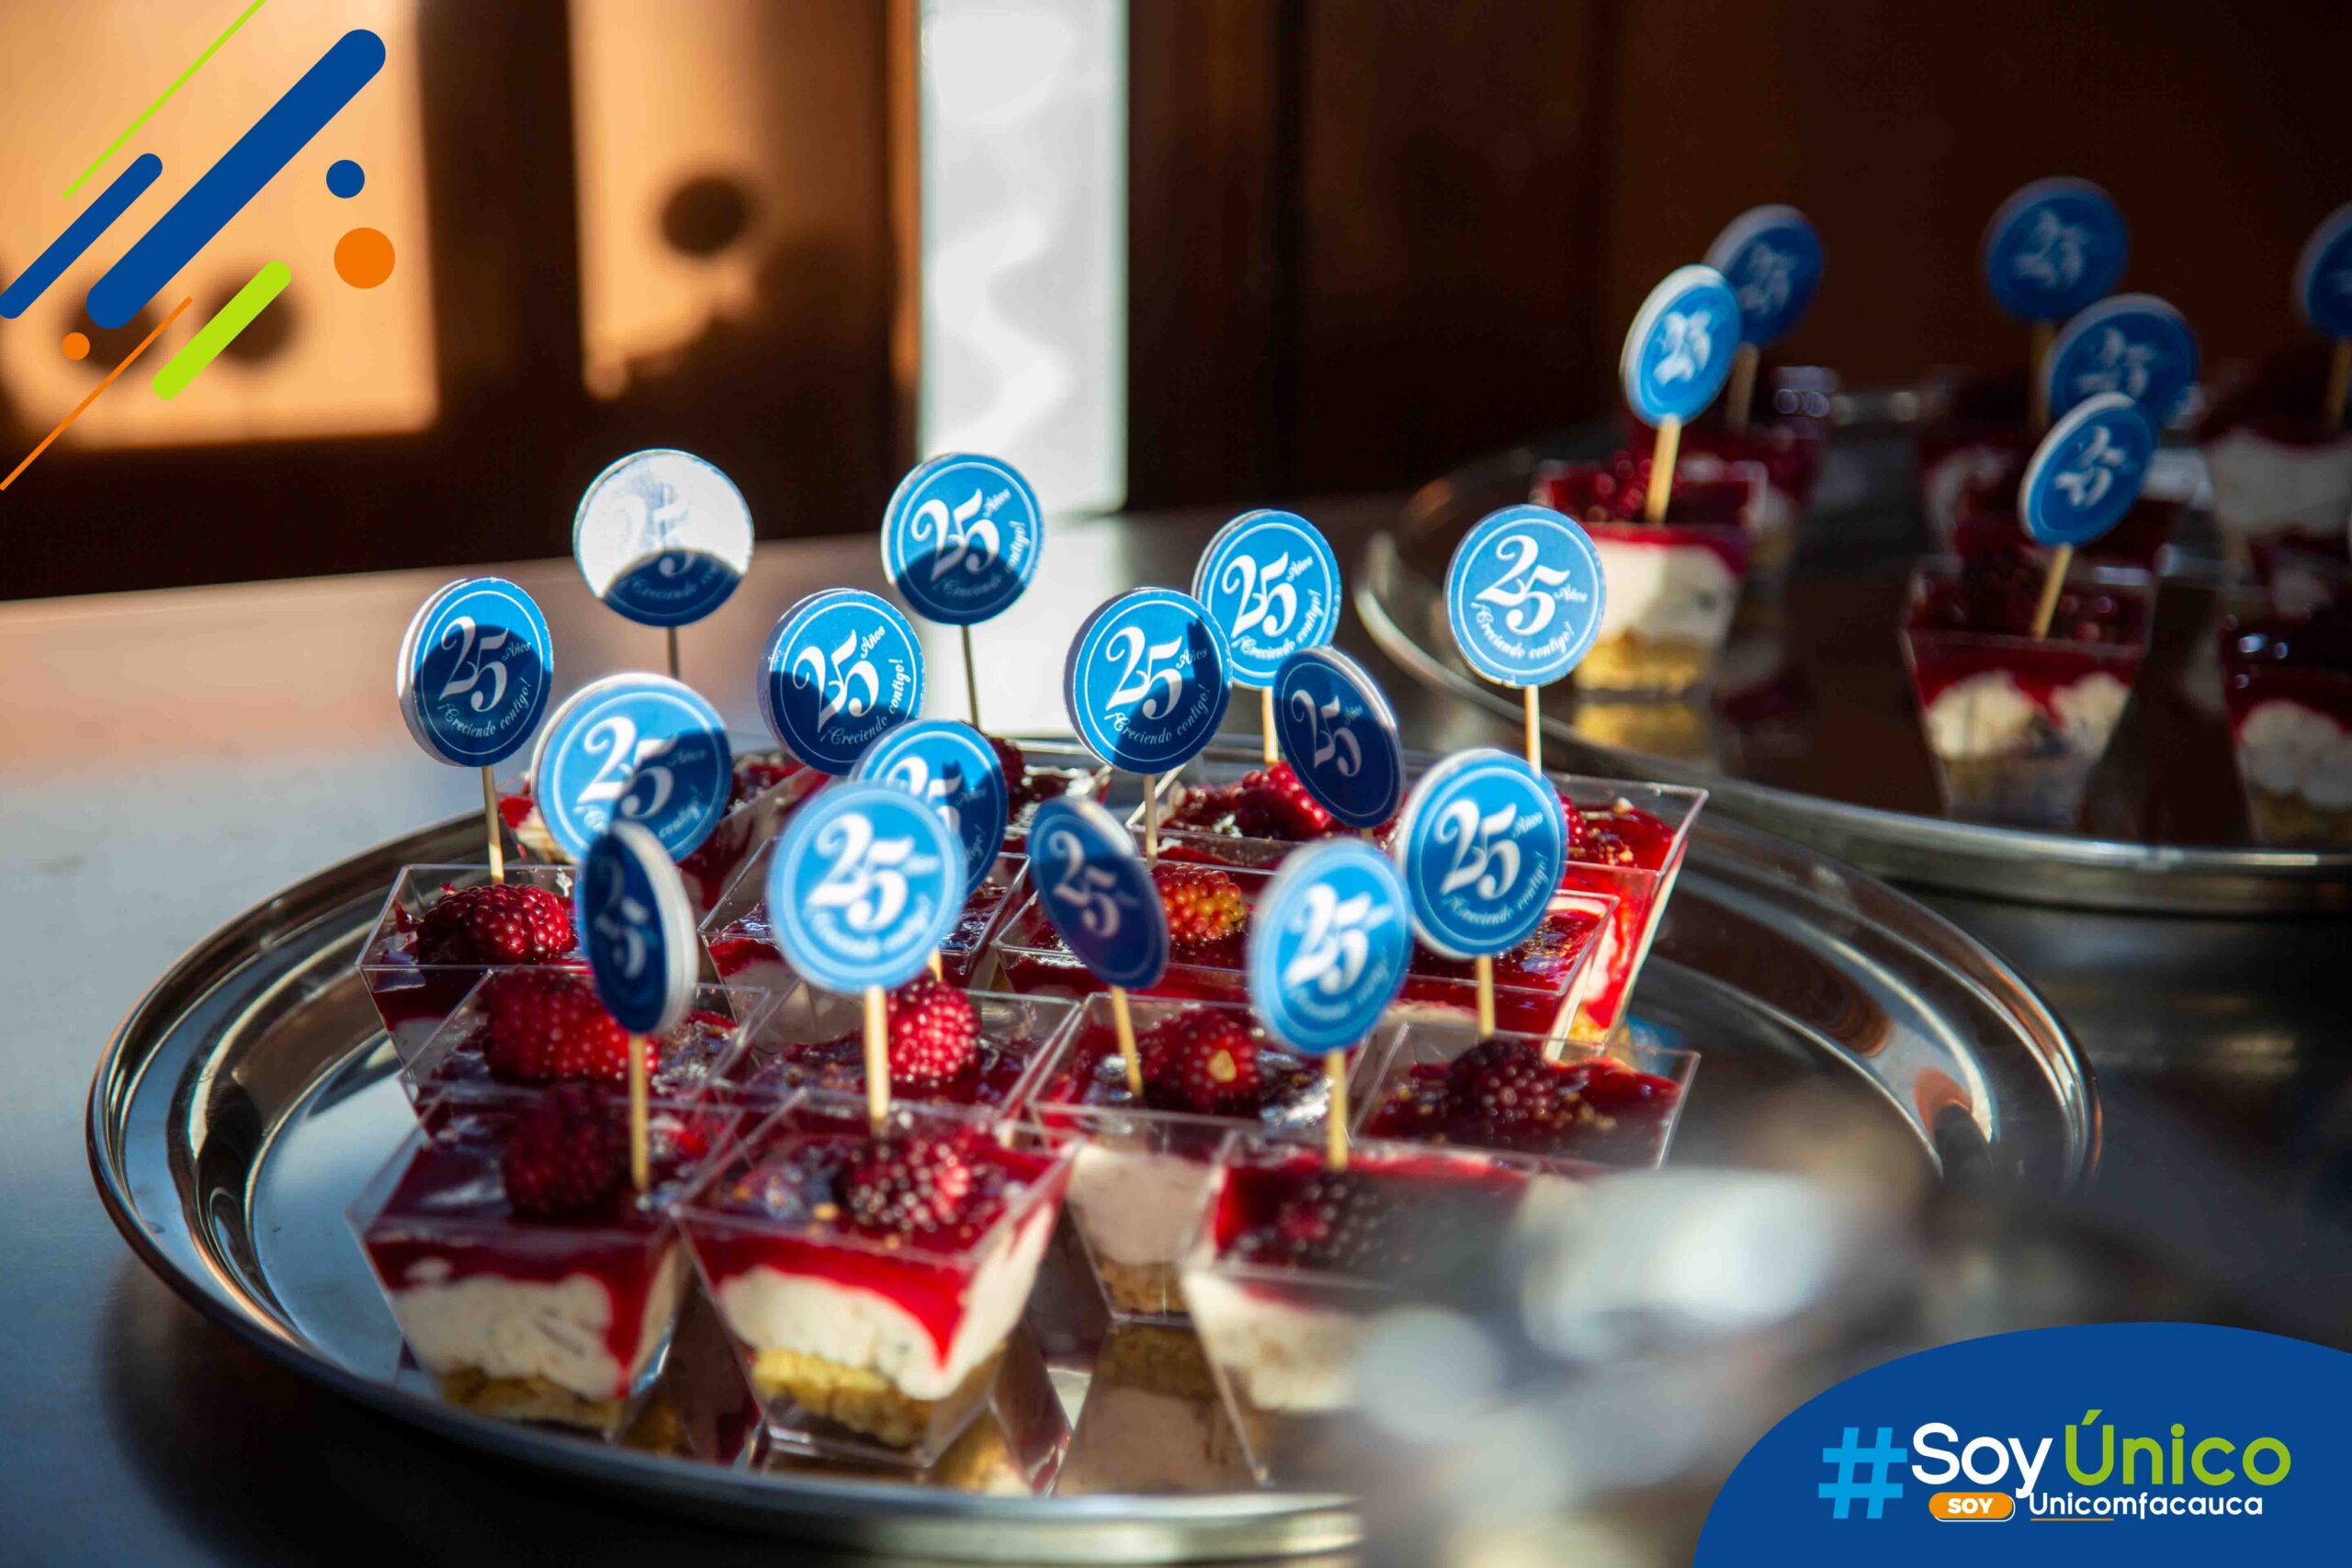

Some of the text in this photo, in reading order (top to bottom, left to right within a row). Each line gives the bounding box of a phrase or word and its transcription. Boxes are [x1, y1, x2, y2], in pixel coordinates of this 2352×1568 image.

[911, 488, 1001, 582] 25
[1222, 551, 1297, 637] 25
[1476, 535, 1570, 636] 25
[439, 615, 532, 713] 25 Años
[500, 678, 532, 731] contigo!
[793, 626, 886, 733] 25 Años
[888, 659, 911, 715] contigo!
[1106, 626, 1182, 720] 25
[1177, 684, 1210, 736] contigo!
[577, 716, 678, 820] 25
[1291, 689, 1362, 777] 25
[808, 813, 914, 932] 25
[1048, 829, 1120, 938] 25
[1434, 798, 1521, 900] 25
[1284, 883, 1372, 995] 25
